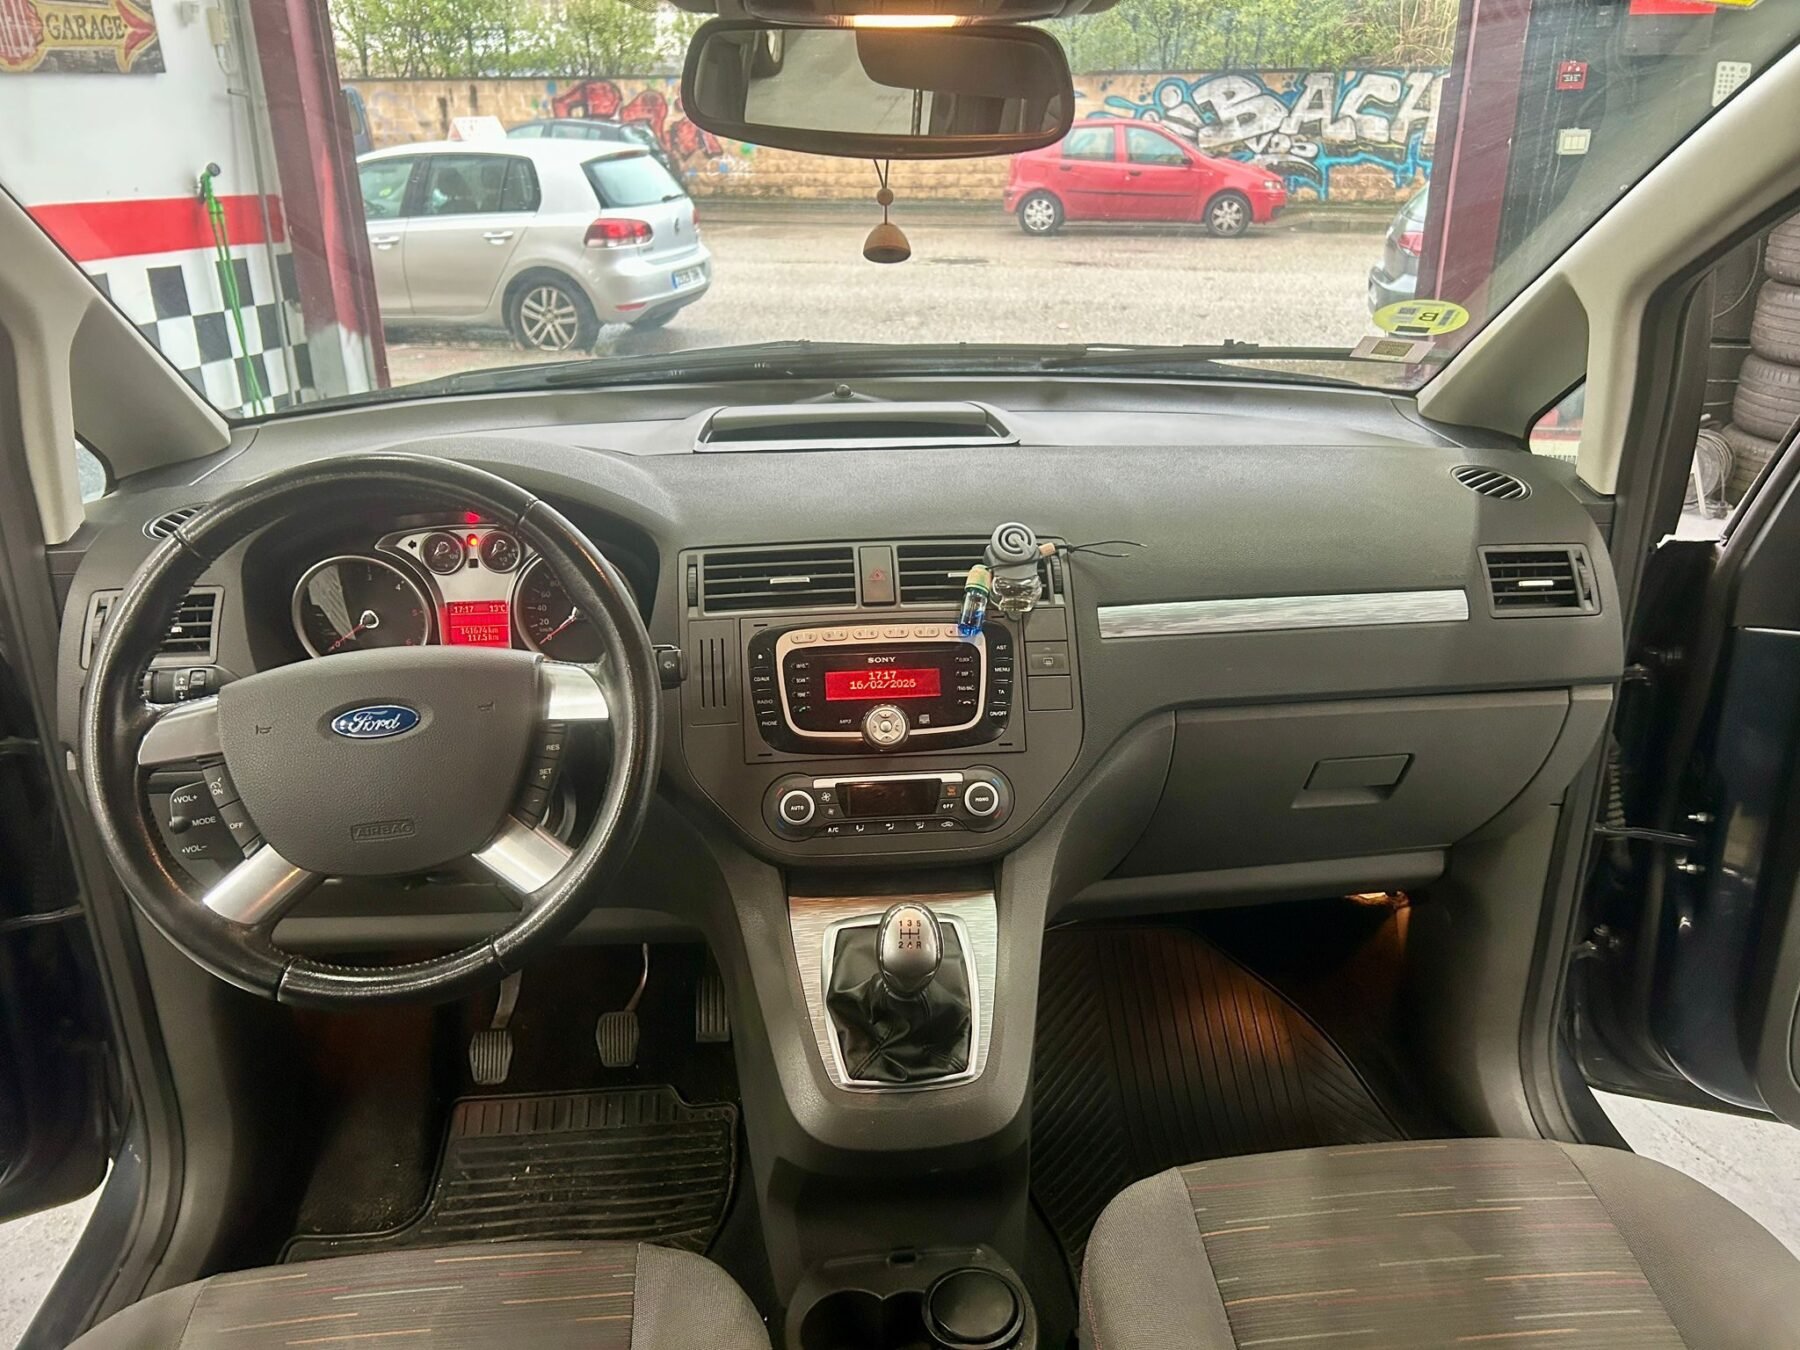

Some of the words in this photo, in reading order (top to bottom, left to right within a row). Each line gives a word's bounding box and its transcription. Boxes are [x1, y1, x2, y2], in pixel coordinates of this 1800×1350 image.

[45, 13, 126, 40] GARAGE
[537, 604, 547, 612] 40
[867, 656, 896, 664] SONY
[347, 710, 401, 733] Ford
[545, 743, 560, 751] RES
[539, 767, 552, 775] SET
[212, 788, 223, 796] ON
[191, 816, 216, 826] MODE
[353, 822, 414, 838] AIRBAG
